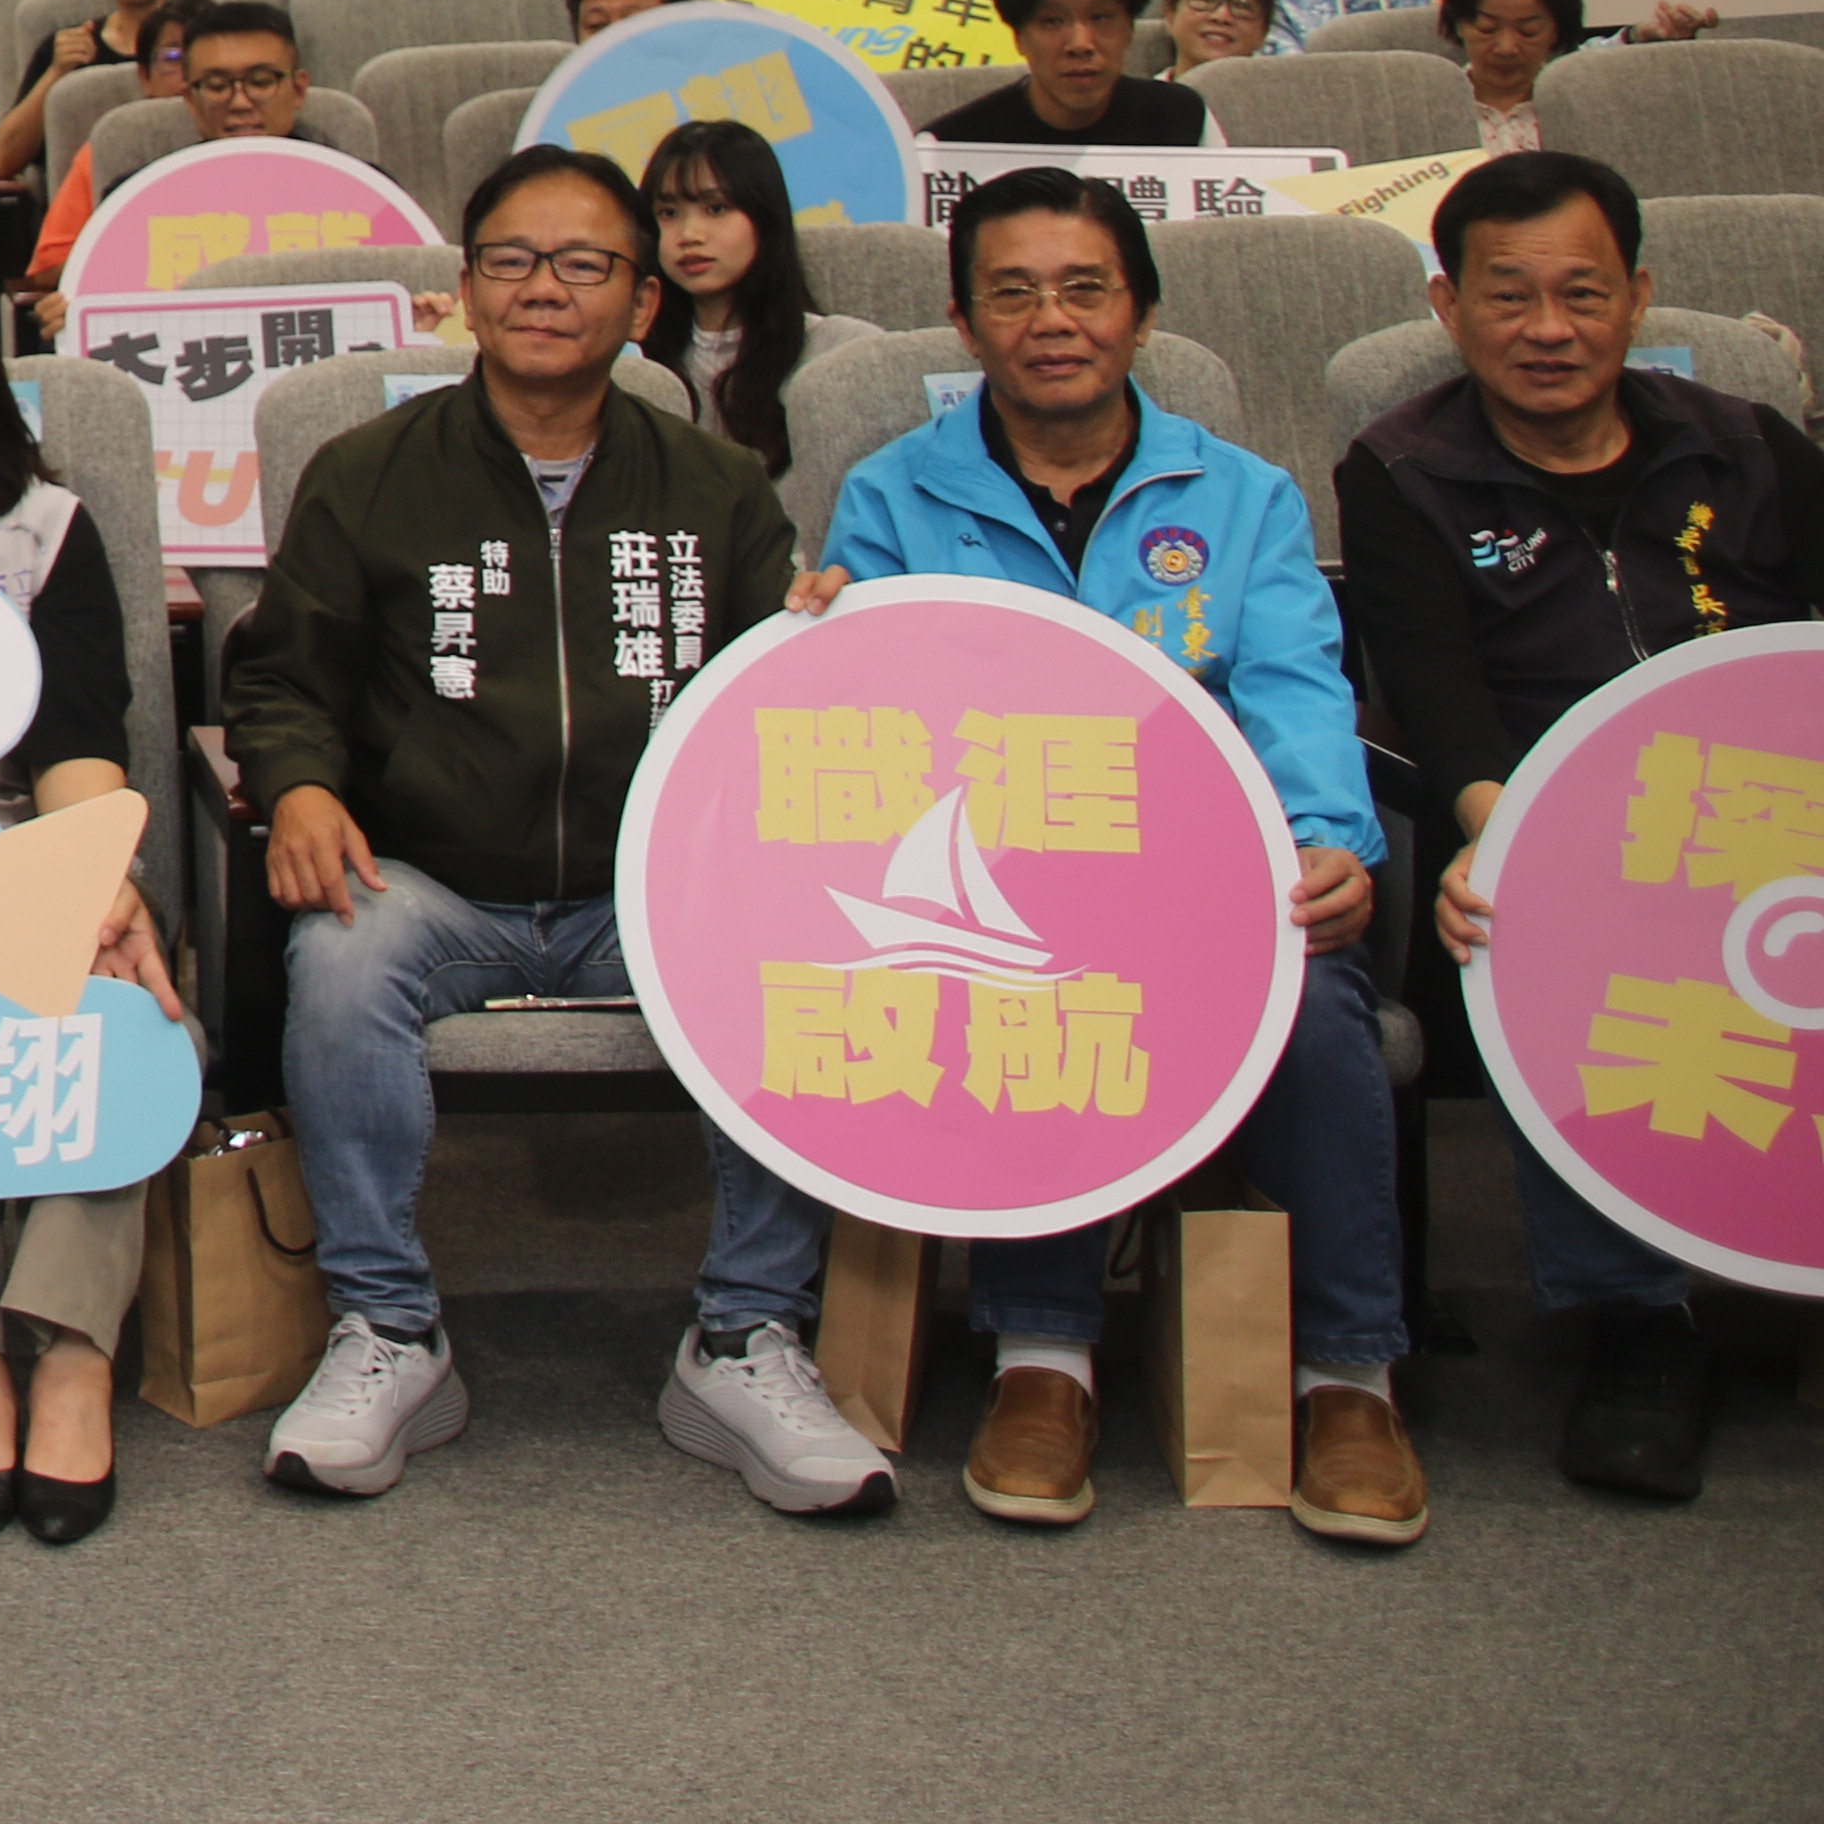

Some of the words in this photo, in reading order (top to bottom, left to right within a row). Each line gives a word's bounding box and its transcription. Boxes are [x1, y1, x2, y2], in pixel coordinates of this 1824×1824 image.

[88, 308, 386, 403] 大步開
[480, 539, 511, 596] 特助
[1504, 528, 1547, 562] TAITUNG
[1508, 552, 1536, 573] CITY
[428, 562, 477, 700] 蔡昇憲
[608, 529, 665, 678] 莊瑞雄
[665, 529, 705, 670] 立法委員
[1132, 604, 1164, 649] 副
[1176, 584, 1218, 676] 臺東
[755, 707, 1141, 854] 職涯
[759, 960, 1149, 1118] 啟航
